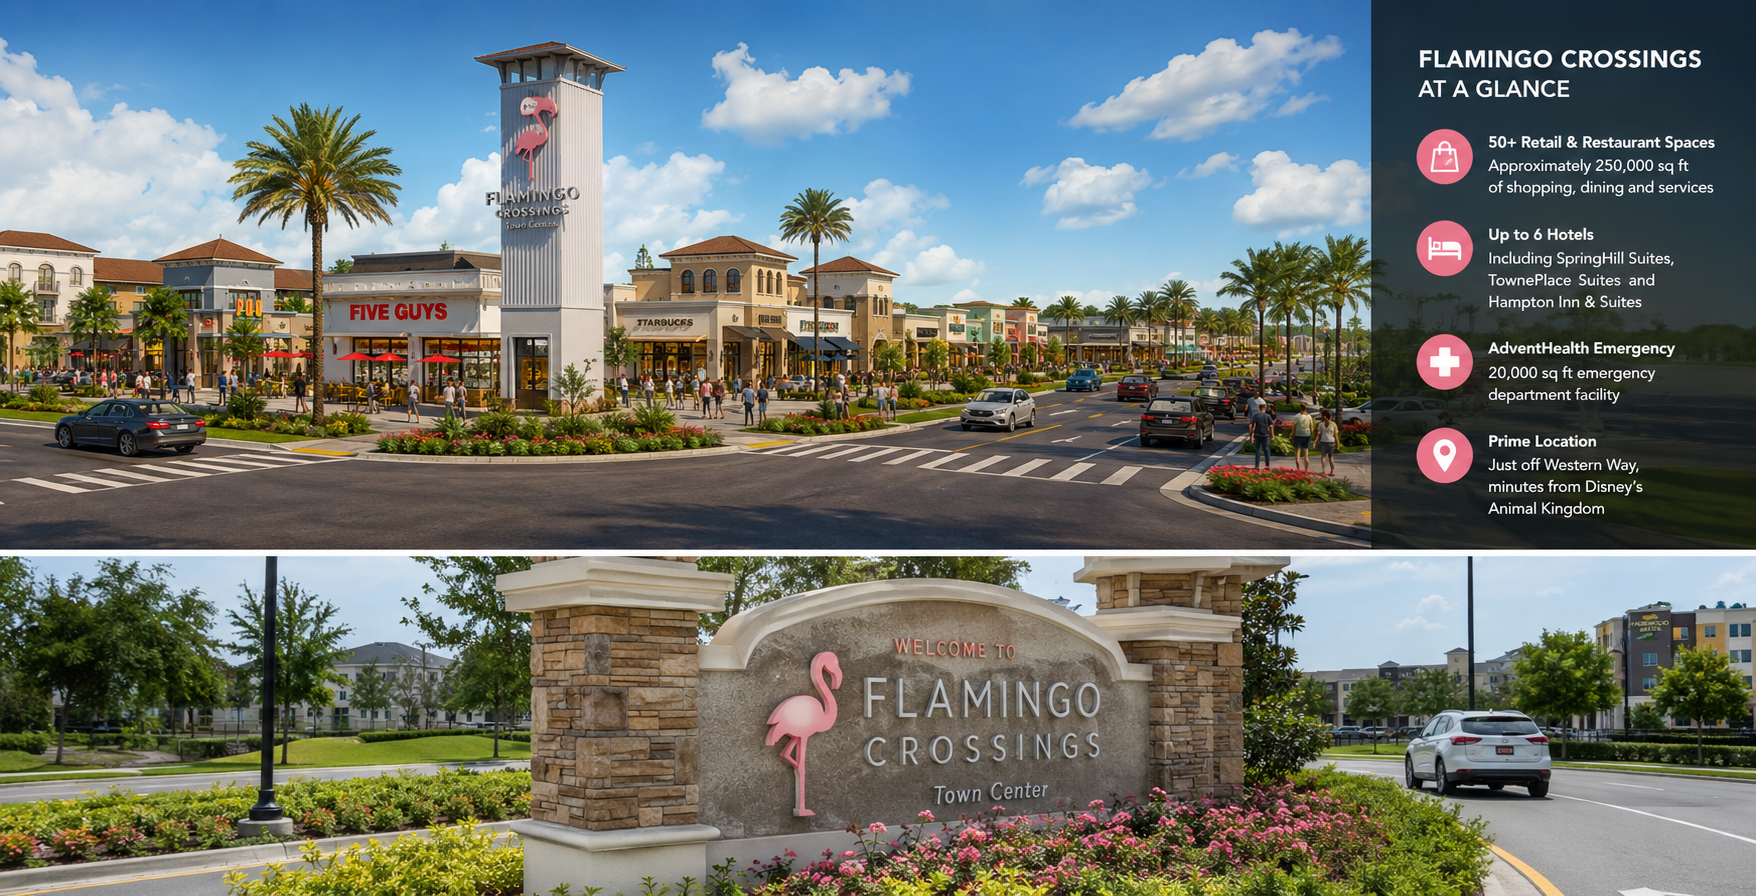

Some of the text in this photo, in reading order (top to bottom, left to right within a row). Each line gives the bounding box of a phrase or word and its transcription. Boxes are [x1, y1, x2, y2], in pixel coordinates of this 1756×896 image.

[485, 187, 580, 206] FLAMINGO
[495, 204, 570, 218] CROSSINGS
[350, 303, 448, 321] FIVE GUYS
[893, 637, 1017, 660] WELCOME TO
[863, 677, 1102, 719] FLAMINGO
[863, 732, 1102, 767] CROSSINGS
[933, 782, 1049, 806] Town Center
